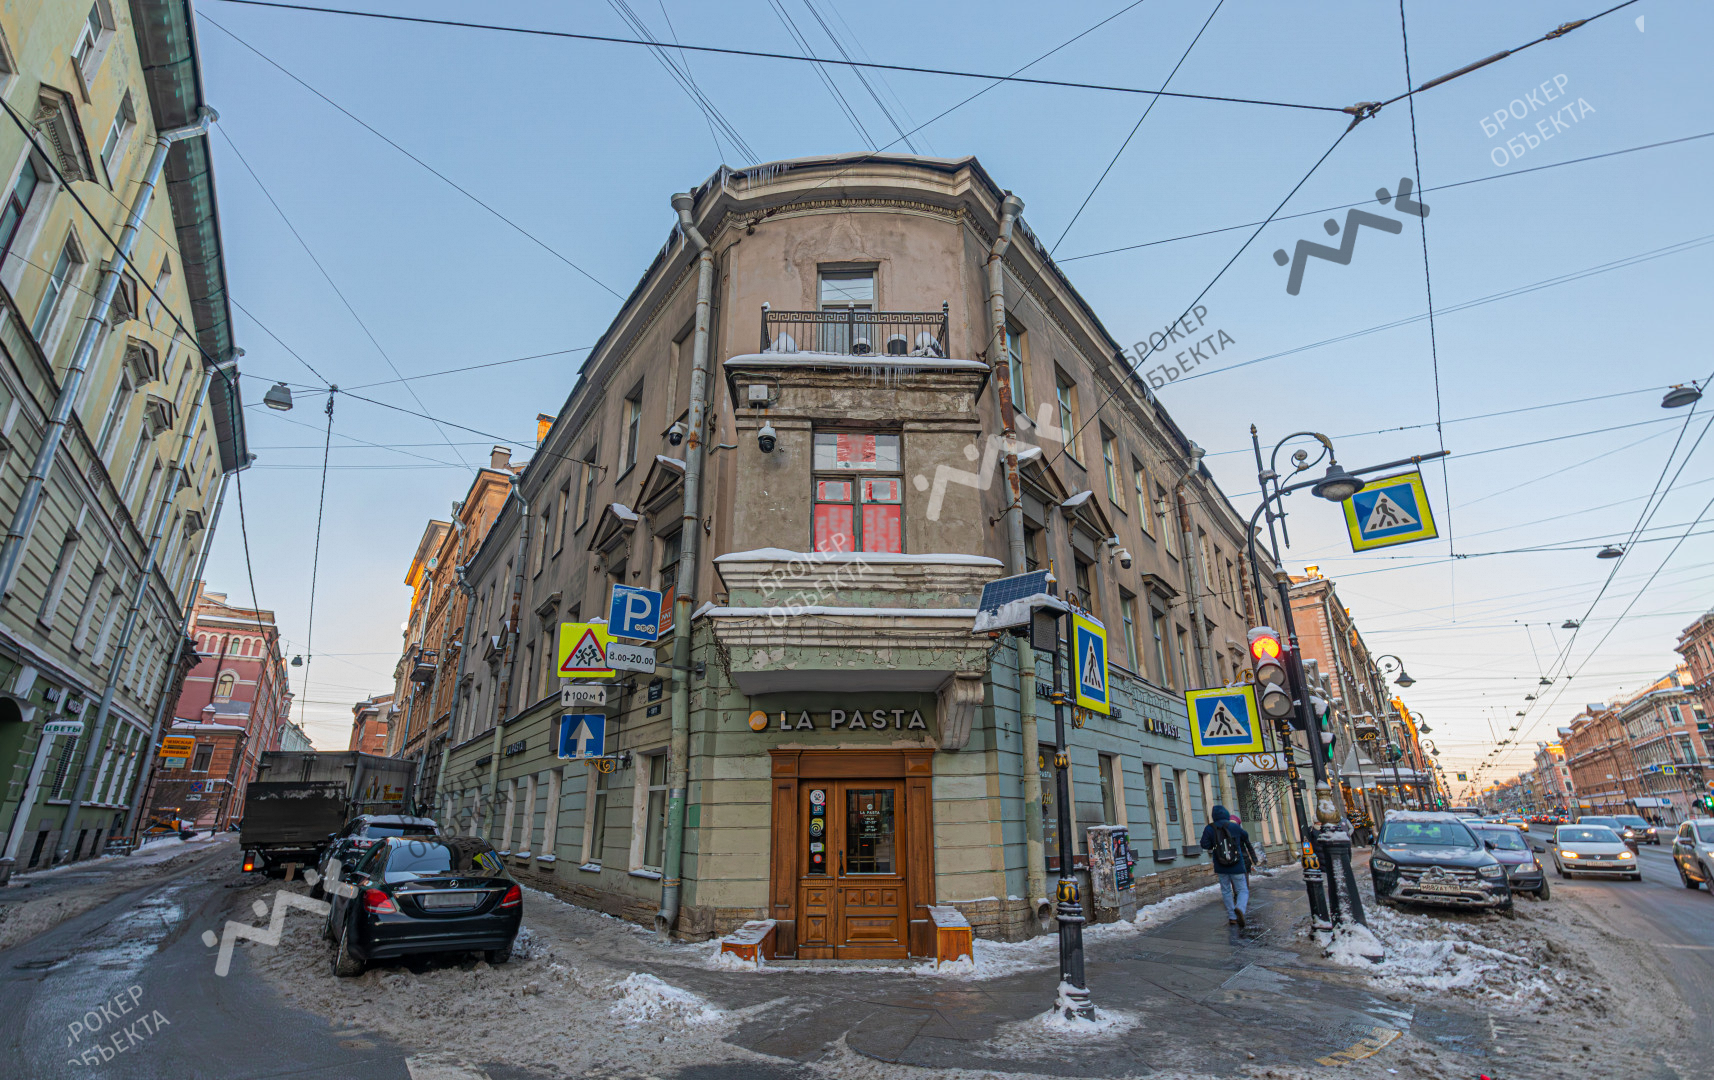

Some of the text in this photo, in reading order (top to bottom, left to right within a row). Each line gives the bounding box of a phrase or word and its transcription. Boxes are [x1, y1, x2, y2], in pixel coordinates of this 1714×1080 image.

[609, 651, 654, 666] 8.00-20.00
[780, 709, 927, 730] LA PASTA
[44, 724, 82, 733] ЦВЕТЫ
